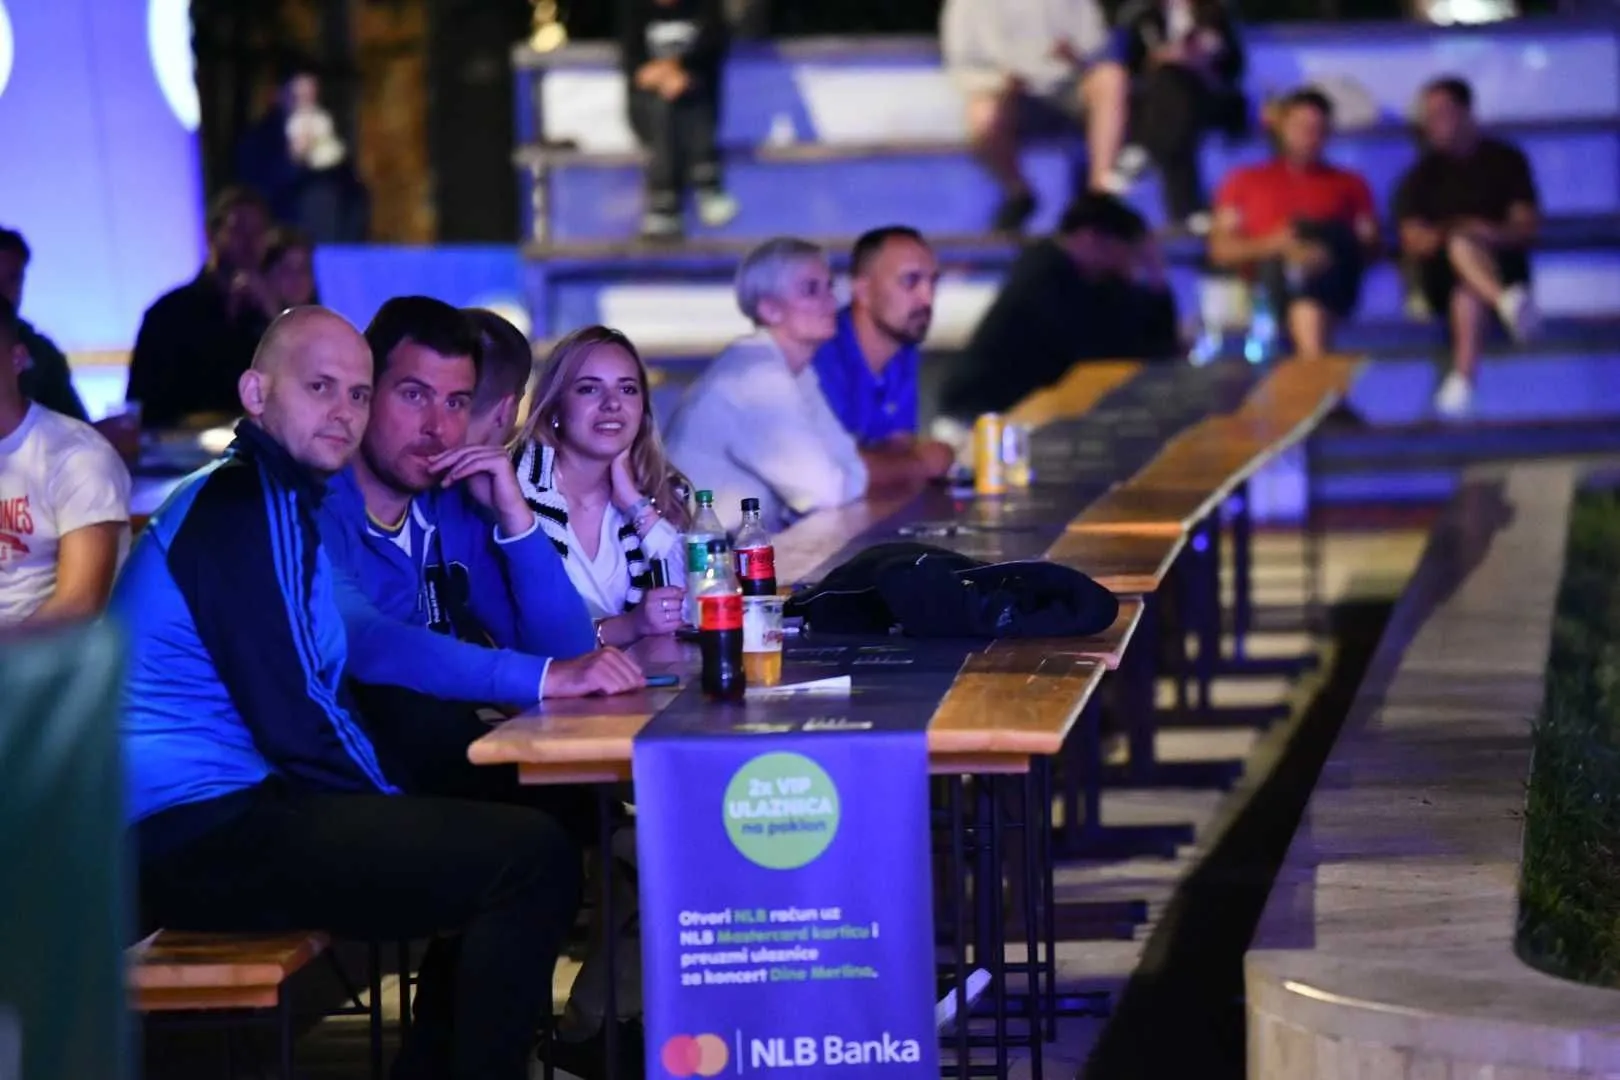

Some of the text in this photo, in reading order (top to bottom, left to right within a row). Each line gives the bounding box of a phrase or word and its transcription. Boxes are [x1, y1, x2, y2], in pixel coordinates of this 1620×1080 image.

[0, 495, 34, 535] NES
[748, 776, 811, 797] 2x VIP
[729, 797, 832, 819] ULAZNICA
[742, 818, 826, 837] na poklon
[679, 908, 732, 926] Otvori
[734, 908, 767, 924] NLB
[820, 906, 841, 921] uz
[680, 930, 714, 946] NLB
[717, 926, 808, 944] Mastercard
[812, 924, 870, 940] karticu
[681, 944, 819, 968] preuzmi ulaznice
[681, 972, 702, 986] za
[704, 968, 768, 985] koncert
[750, 1032, 921, 1068] NLB Banka
